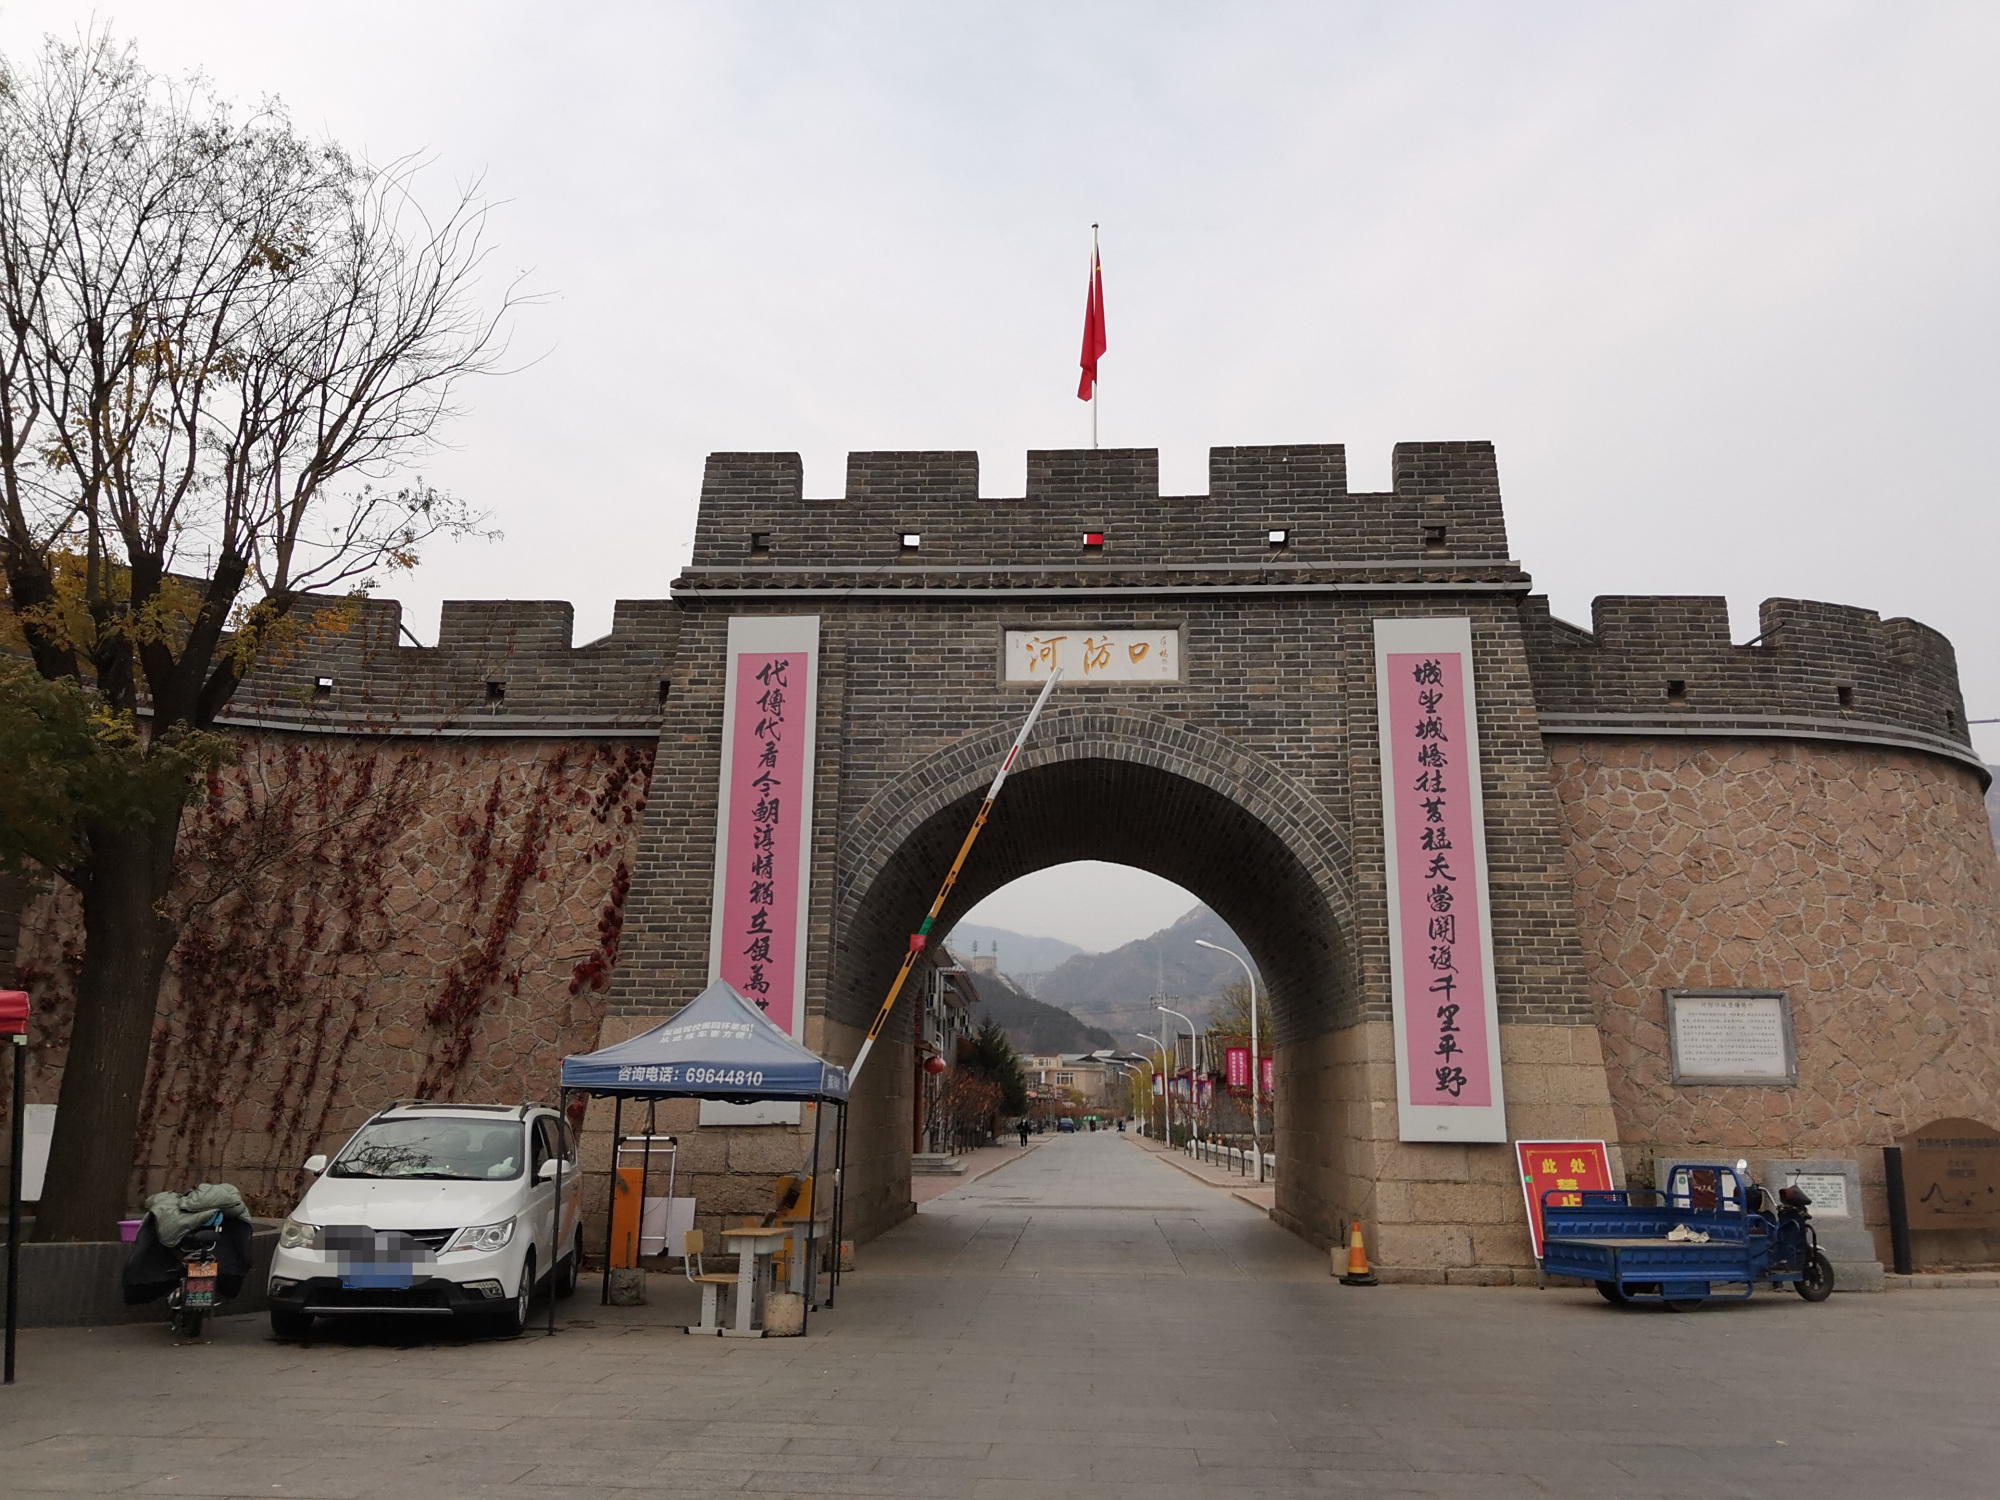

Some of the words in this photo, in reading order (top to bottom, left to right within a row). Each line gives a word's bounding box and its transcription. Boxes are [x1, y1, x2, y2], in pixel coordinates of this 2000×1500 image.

[1025, 635, 1150, 676] 河防口
[1542, 1158, 1586, 1174] 此处
